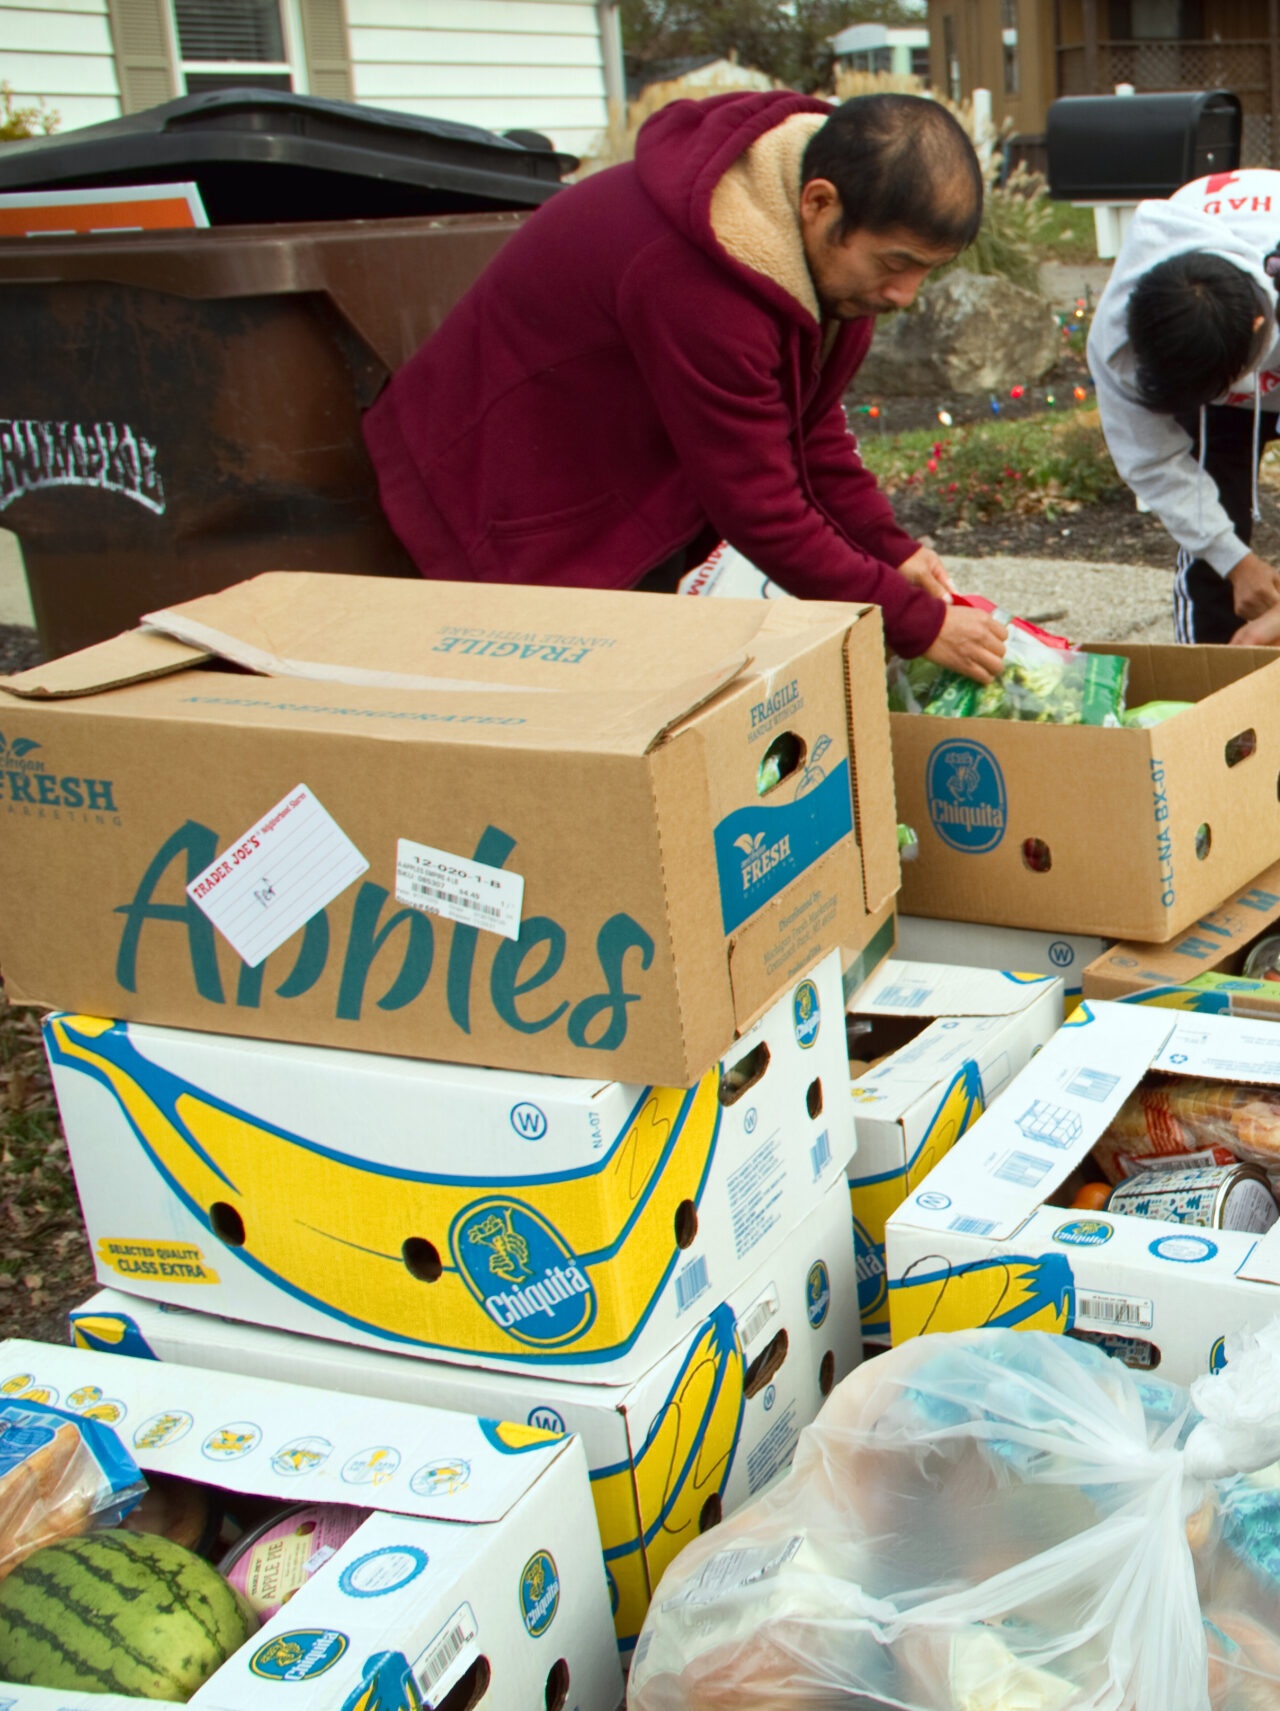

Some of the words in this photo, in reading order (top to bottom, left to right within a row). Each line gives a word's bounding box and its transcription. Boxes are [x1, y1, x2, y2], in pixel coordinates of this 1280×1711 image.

[432, 637, 592, 665] FRAGILE
[750, 679, 799, 728] FRAGILE
[1150, 758, 1169, 822] BX-07
[932, 800, 1003, 832] Chiquita
[193, 860, 234, 899] TRADER
[233, 834, 261, 866] JOE'S
[741, 834, 791, 890] FRESH
[117, 1258, 159, 1276] CLASS
[159, 1262, 207, 1279] EXTRA
[156, 1248, 200, 1260] QUALITY
[486, 1264, 591, 1328] Chiquita
[267, 1540, 284, 1562] PIE
[261, 1560, 281, 1601] APPLE
[525, 1578, 560, 1629] Chiquita
[284, 1631, 341, 1681] Chiquita
